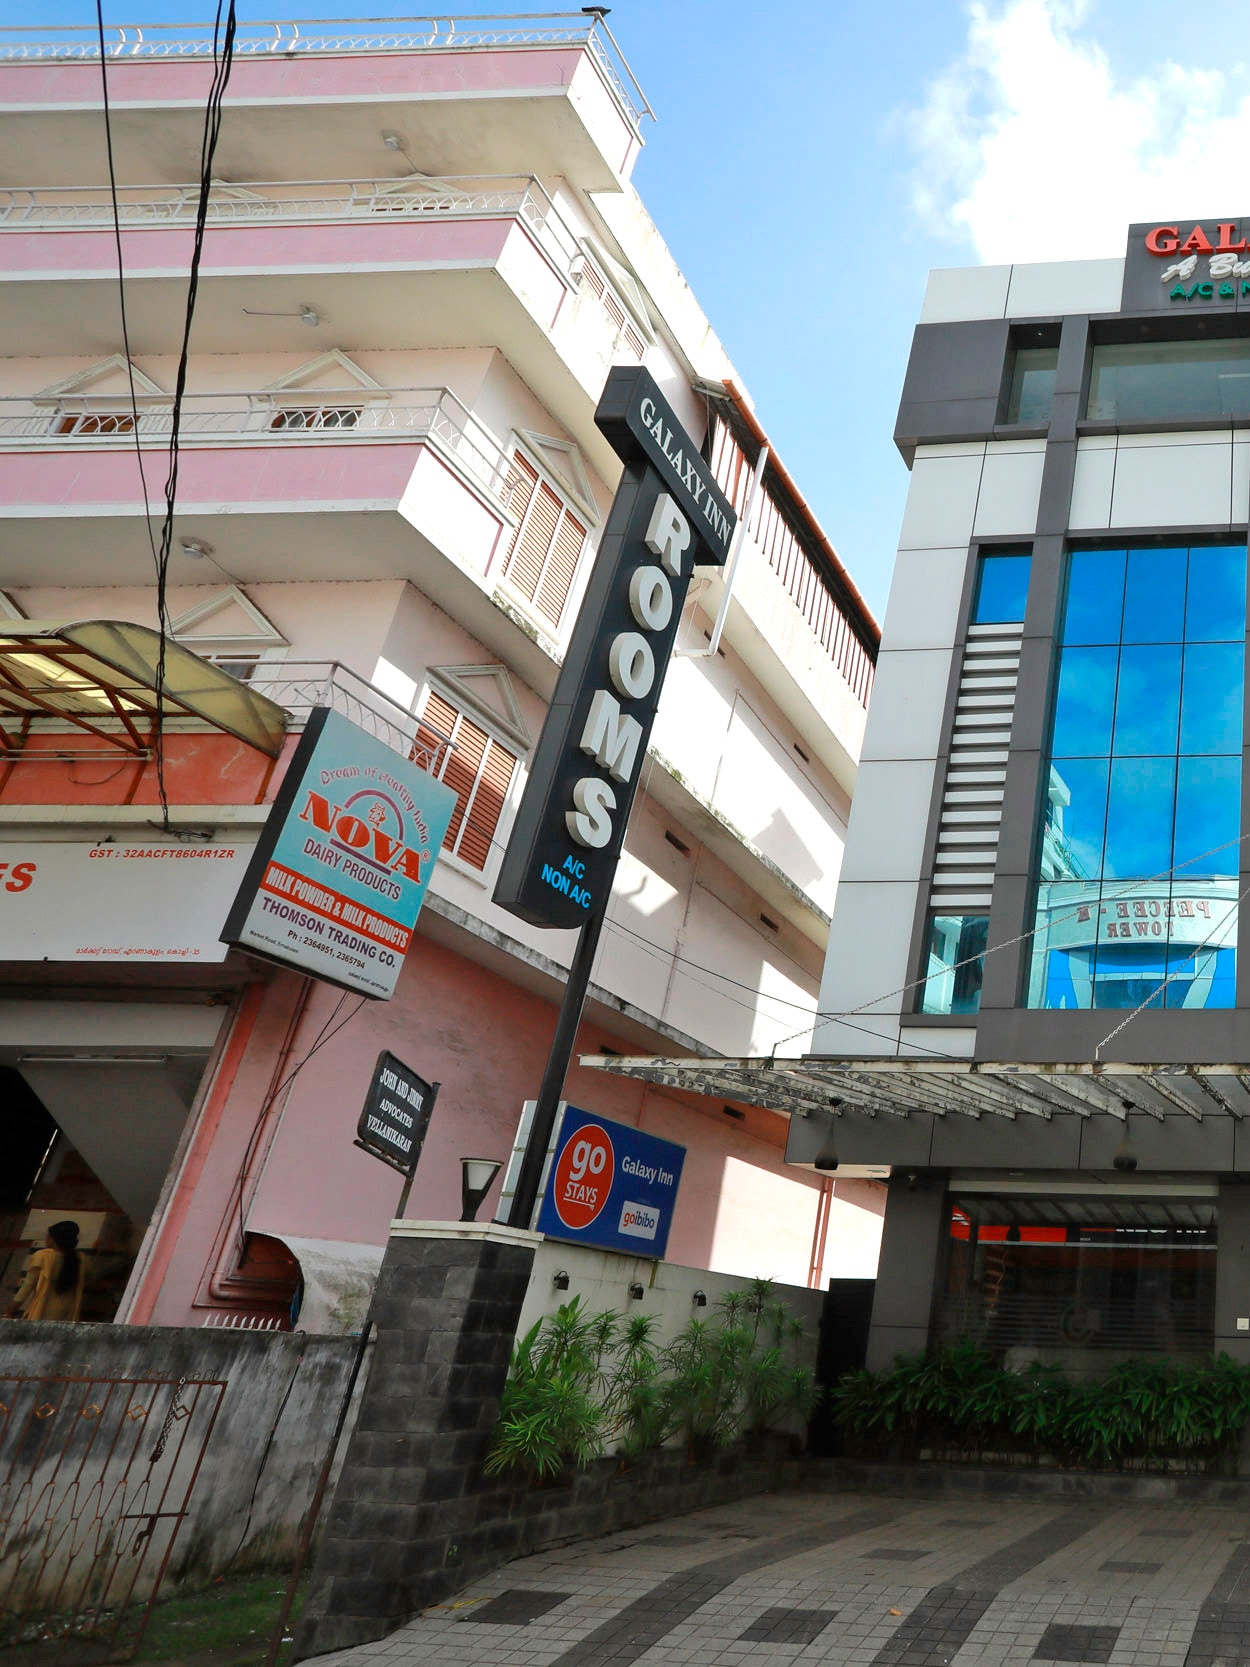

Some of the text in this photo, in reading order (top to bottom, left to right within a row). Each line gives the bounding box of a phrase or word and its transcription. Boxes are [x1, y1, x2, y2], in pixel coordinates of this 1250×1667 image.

[1161, 255, 1198, 283] A
[1170, 281, 1214, 301] A/C
[1218, 282, 1235, 299] &
[640, 397, 732, 546] GALAXY INN
[565, 492, 690, 849] ROOMS
[320, 767, 429, 844] Dream of Healthy India
[88, 849, 113, 858] GST
[299, 790, 421, 884] NOVA
[304, 838, 401, 901] DAIRY PRODUCTS
[541, 864, 592, 908] NON A/C
[563, 854, 585, 879] A/C
[266, 866, 409, 949] MILK POWDER & MILK PRODUCTS
[262, 897, 397, 969] THOMSON TRADING CO.
[287, 929, 298, 941] Ph
[336, 951, 366, 969] 2365794
[380, 1067, 398, 1092] JOHN
[395, 1079, 409, 1099] AND
[379, 1098, 414, 1128] ADVOCATES
[569, 1140, 606, 1181] go
[622, 1156, 674, 1186] Galaxy Inn
[564, 1181, 598, 1203] STAYS
[623, 1211, 655, 1229] goibibo
